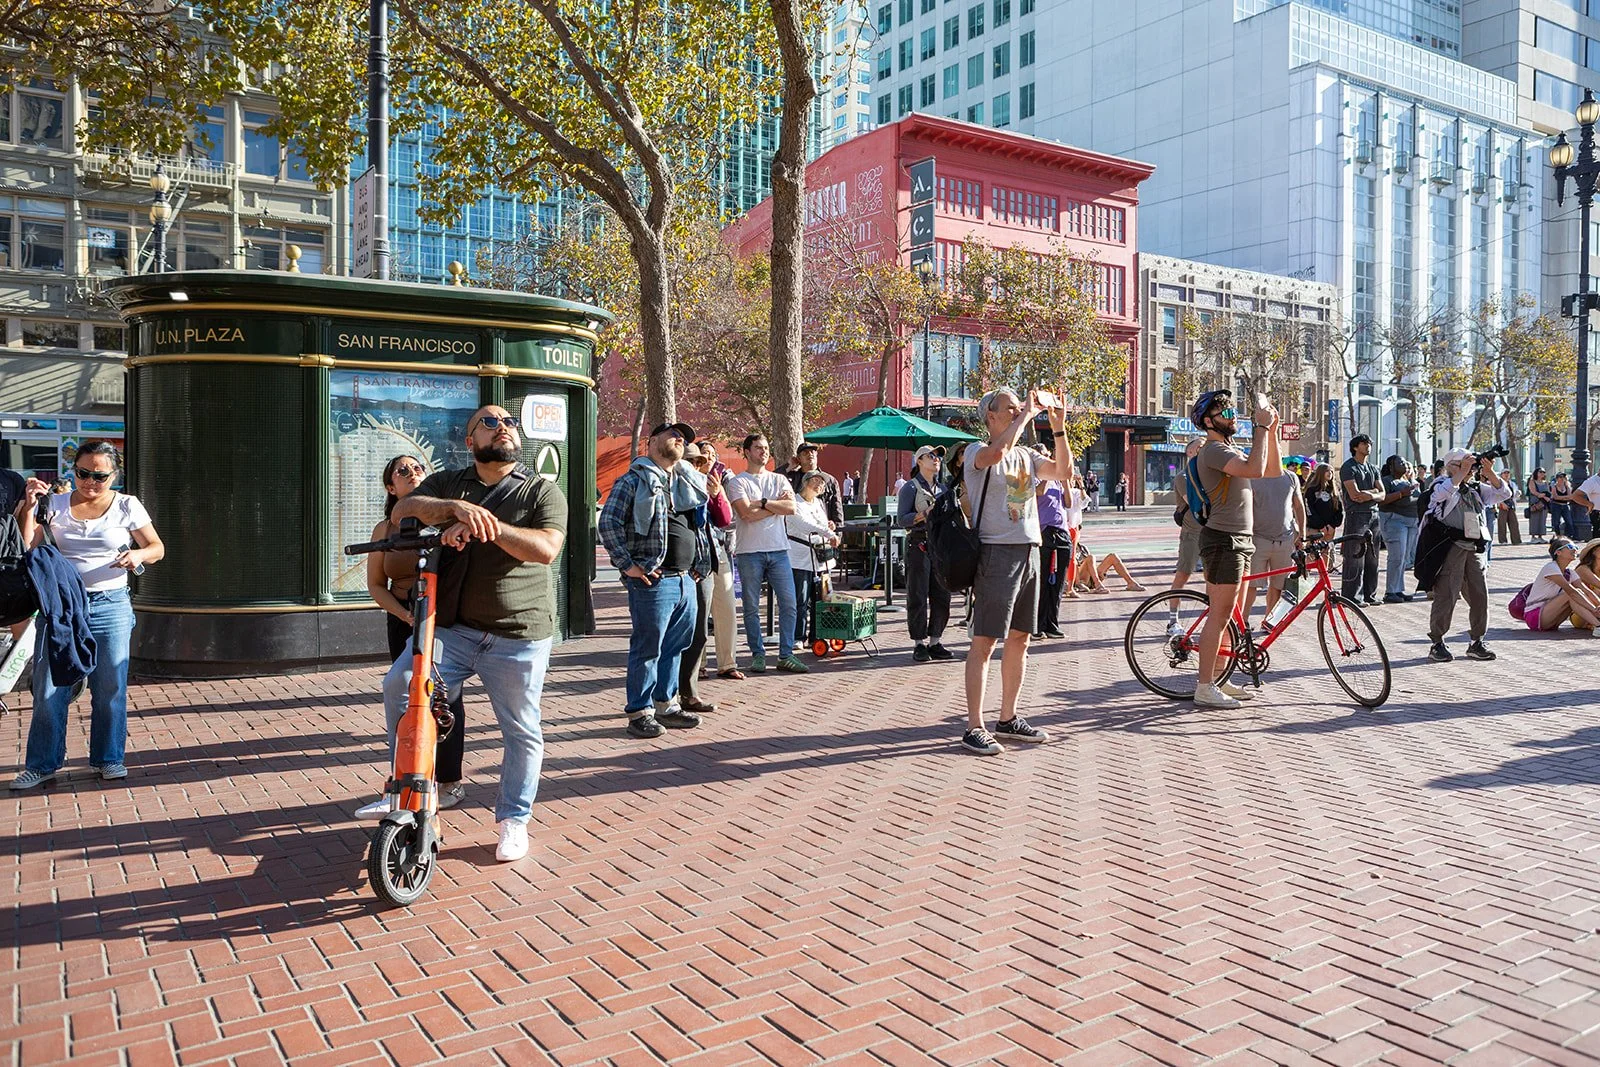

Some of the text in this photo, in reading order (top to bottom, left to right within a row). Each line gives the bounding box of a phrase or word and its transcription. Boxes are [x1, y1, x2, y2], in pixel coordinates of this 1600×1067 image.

[359, 185, 368, 200] BUS
[359, 202, 368, 215] AND
[802, 181, 847, 226] HEATER
[357, 235, 368, 251] LANE
[355, 252, 369, 267] AHEAD
[156, 327, 245, 344] U.N. PLAZA
[338, 333, 476, 355] SAN FRANCISCO
[543, 347, 583, 368] TOILET
[363, 376, 474, 391] SAN FRANCISCO
[409, 386, 470, 400] Downtown
[1103, 417, 1137, 425] THEATER
[1, 648, 27, 679] Lime
